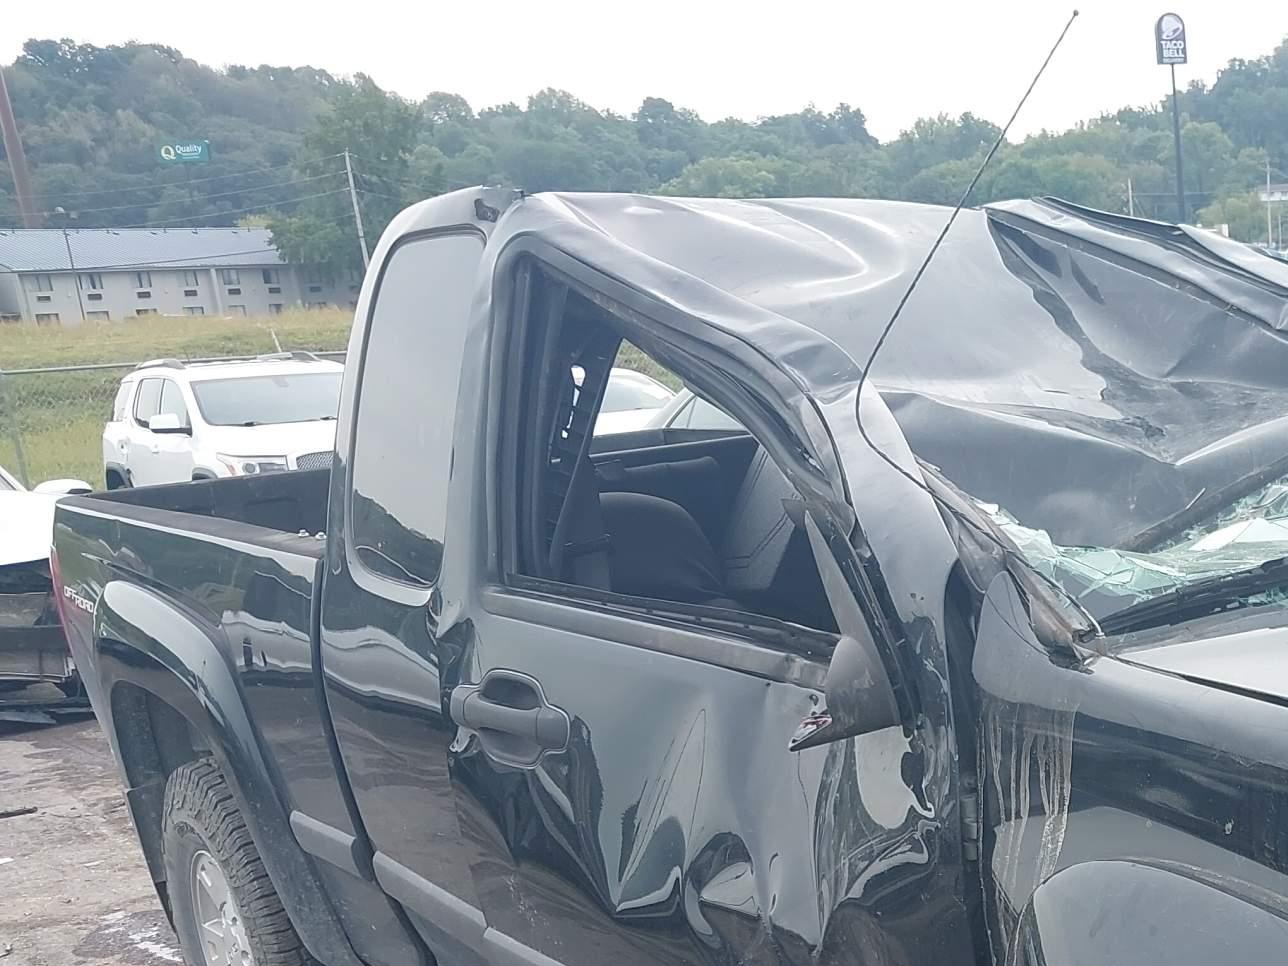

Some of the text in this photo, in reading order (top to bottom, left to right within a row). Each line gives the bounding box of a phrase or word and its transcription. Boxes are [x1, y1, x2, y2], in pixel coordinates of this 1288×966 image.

[1160, 40, 1184, 49] TACO
[1162, 49, 1185, 58] BELL
[175, 144, 202, 154] Quality
